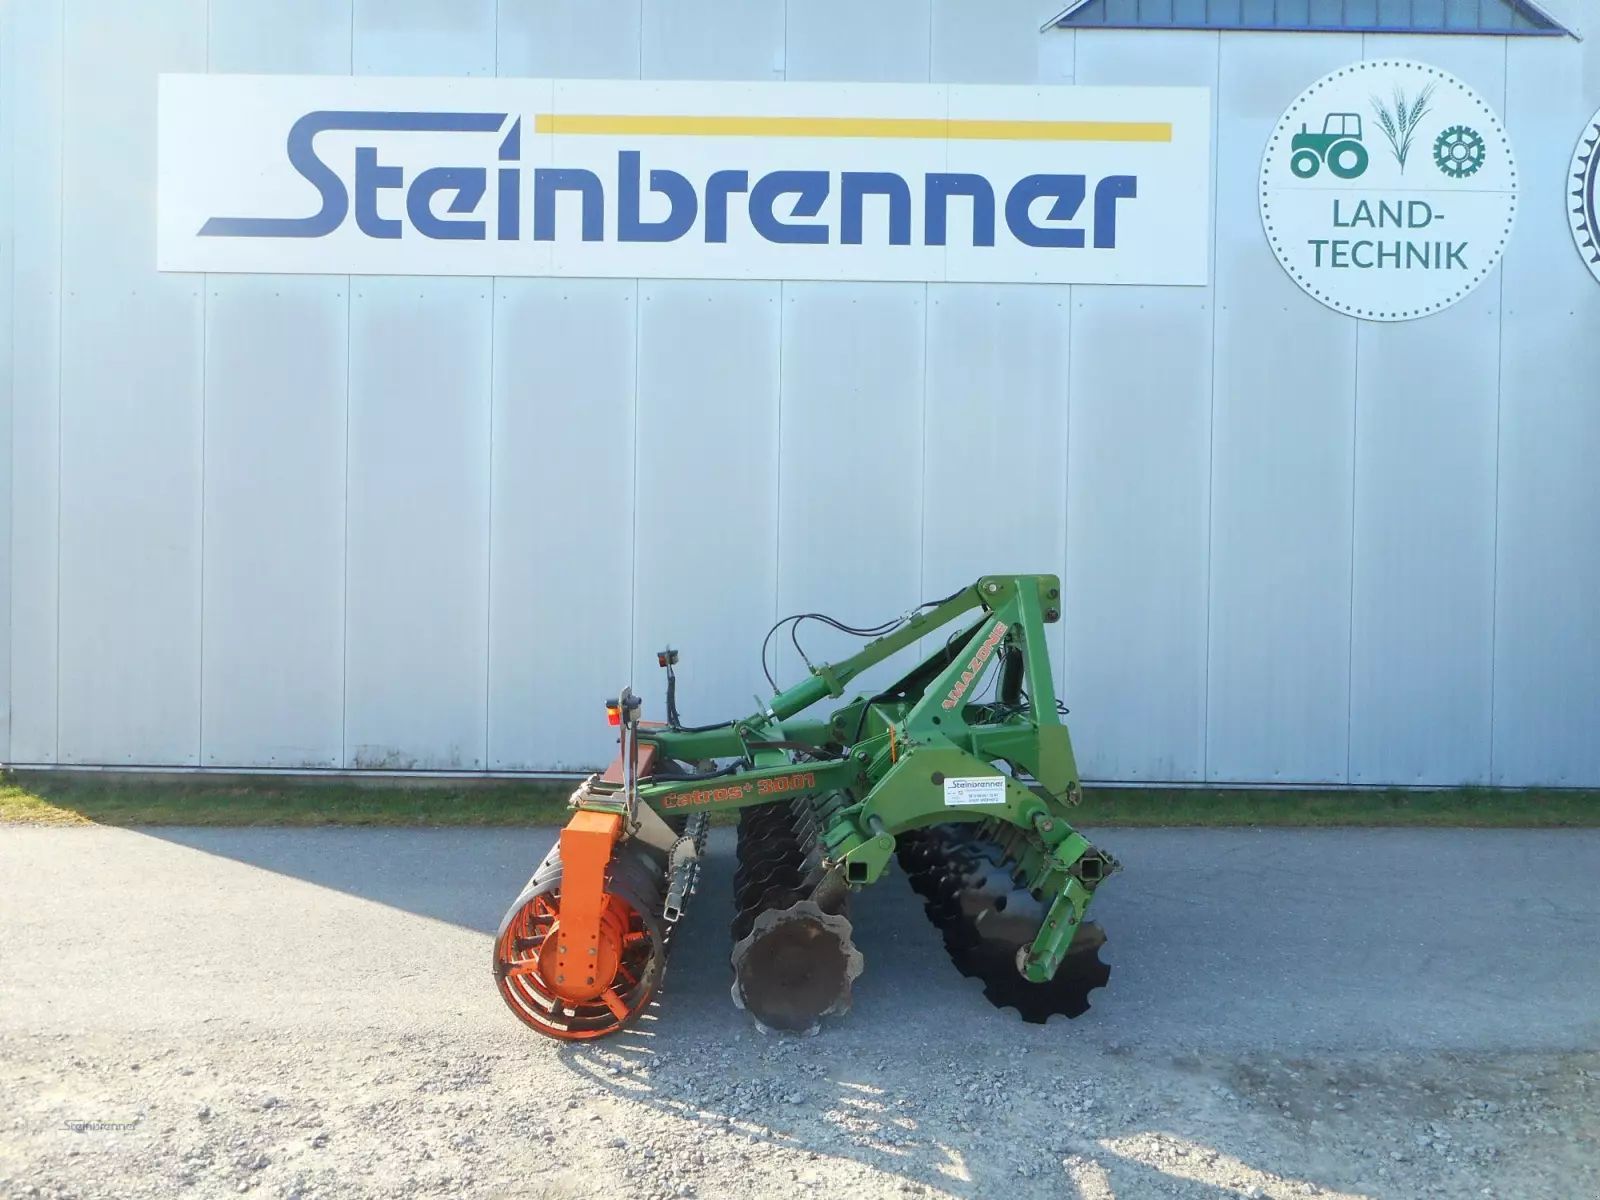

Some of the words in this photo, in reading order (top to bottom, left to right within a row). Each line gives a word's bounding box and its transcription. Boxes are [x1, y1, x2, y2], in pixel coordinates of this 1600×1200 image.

[196, 111, 1138, 249] Steinbrenner
[1333, 199, 1445, 228] LAND-
[1307, 239, 1469, 270] TECHNIK
[941, 621, 1008, 712] AMAZONE
[948, 780, 1003, 789] Steinbrenner
